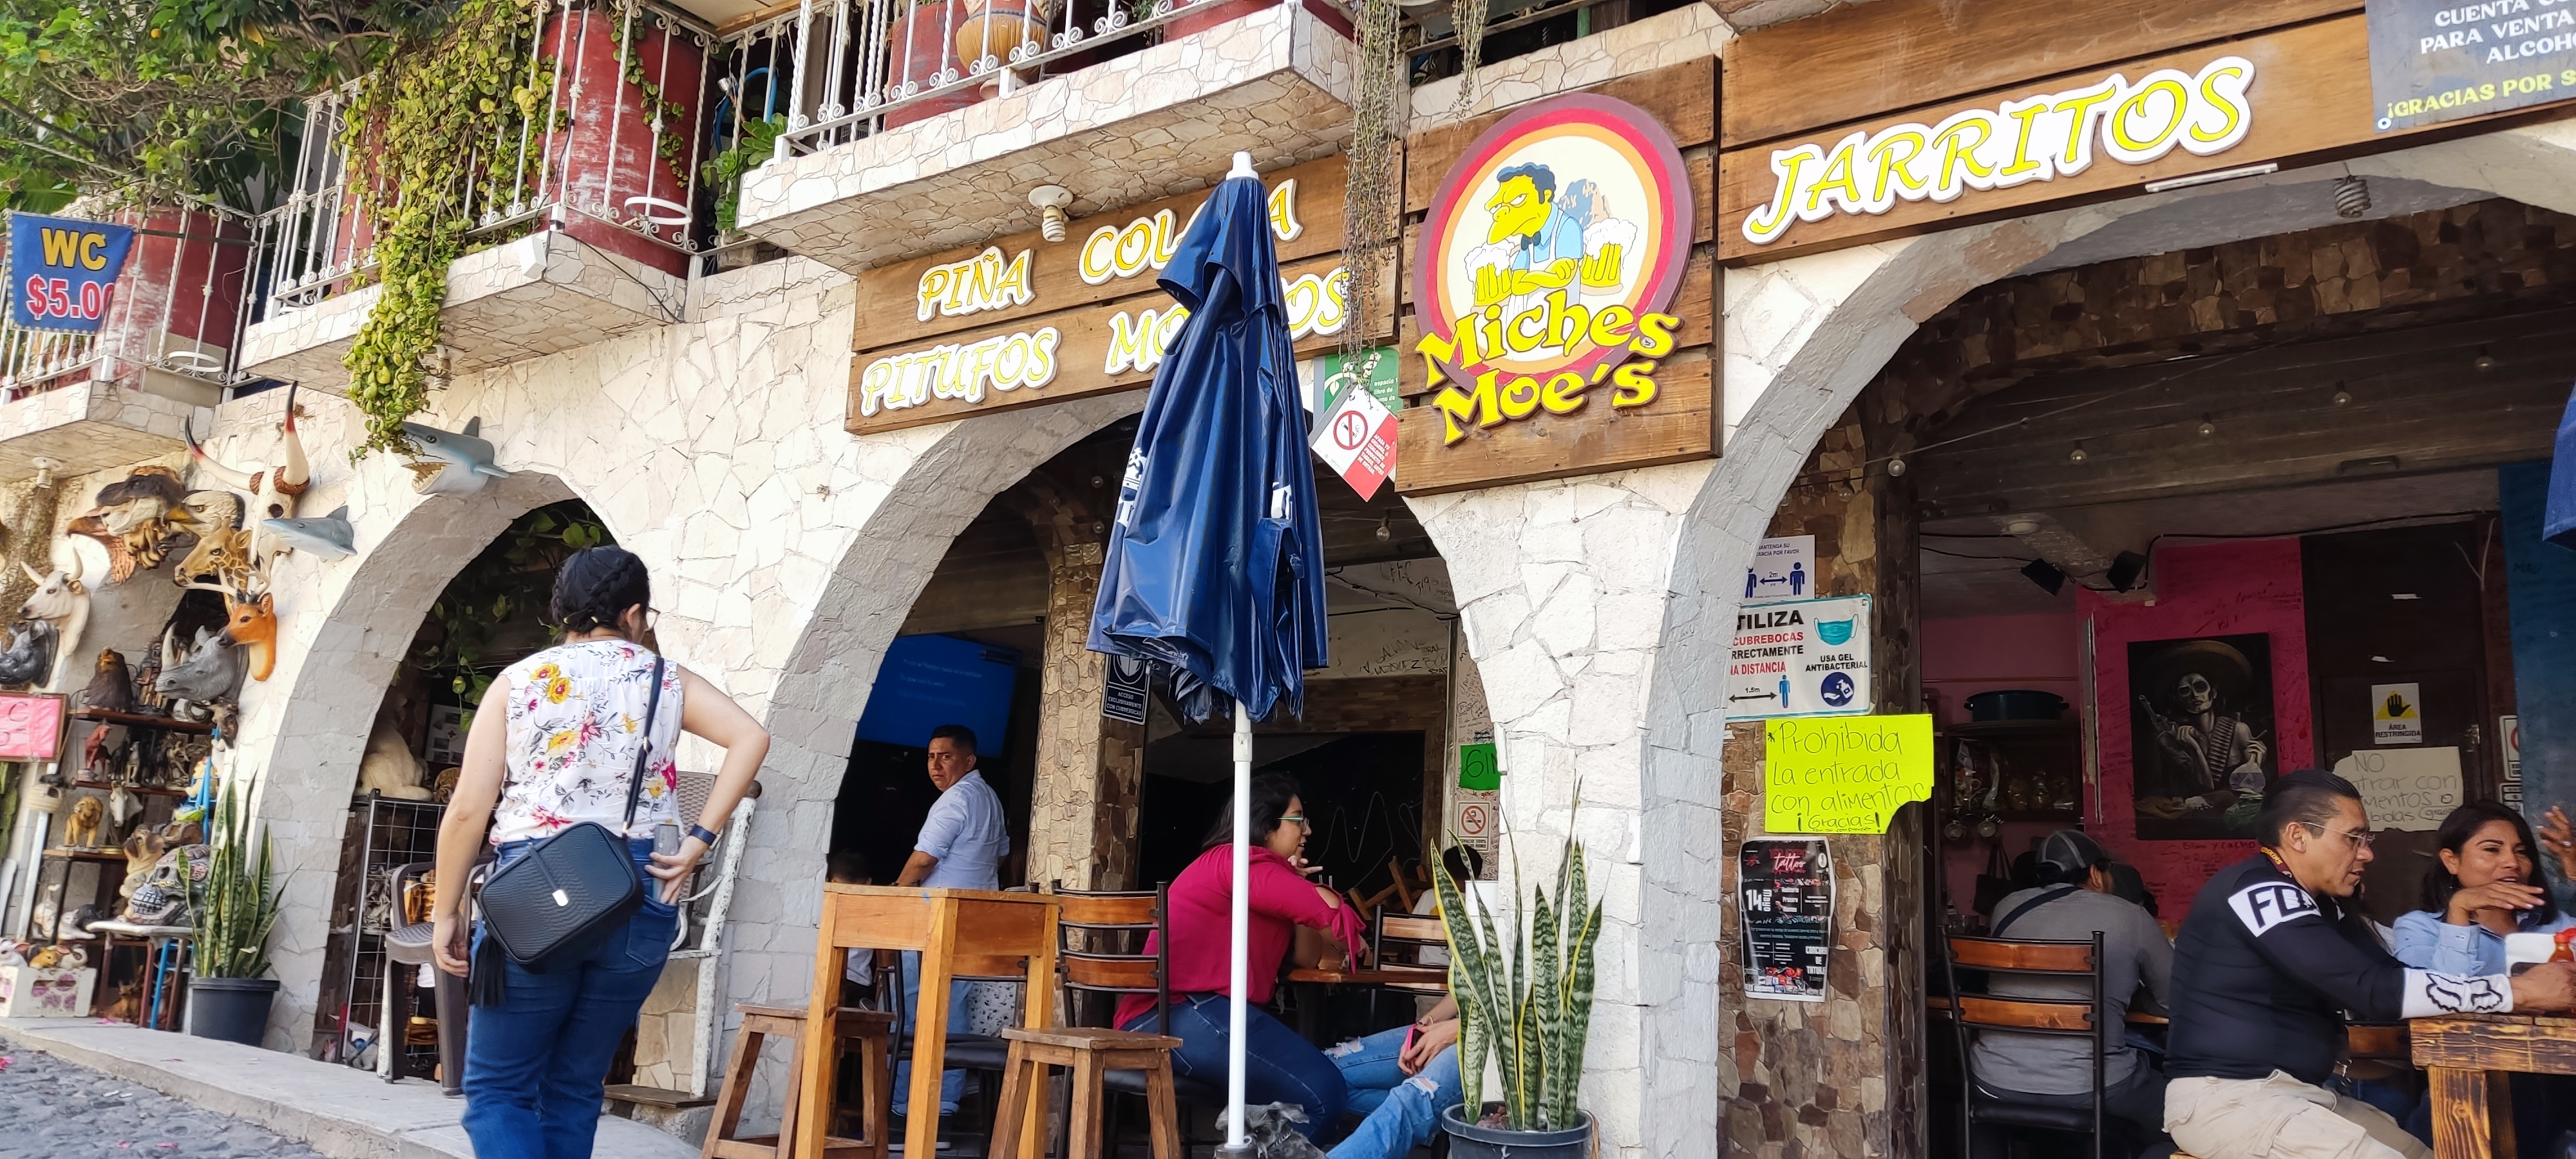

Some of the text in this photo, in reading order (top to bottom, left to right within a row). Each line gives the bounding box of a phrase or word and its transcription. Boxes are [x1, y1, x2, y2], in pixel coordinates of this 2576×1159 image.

[2435, 0, 2530, 27] CUENTA
[2421, 9, 2575, 54] PARA VENTA
[2387, 69, 2576, 118] ¡GRACIAS POR S
[1747, 62, 2248, 238] JARRITOS
[41, 227, 107, 271] WC
[919, 184, 1296, 316] PIÑA COLA
[863, 270, 1351, 413] PITUFOS MOOS
[1416, 289, 1680, 388] Miches
[1431, 361, 1656, 446] Moe's
[1737, 610, 1804, 630] TILIZA
[1733, 632, 1804, 646] CUBREBOCAS
[1732, 645, 1804, 659] RRECTAMENTE
[1741, 661, 1786, 675] DISTANCIA
[1805, 661, 1868, 672] ANTIBACTERIAL
[1108, 696, 1142, 709] EXCLUSIVAMENTE
[1115, 705, 1141, 716] CUBREBOCAS
[1779, 721, 1902, 757] Prohibida
[1774, 759, 1900, 786] La entrada
[2354, 753, 2385, 773] NO
[2351, 775, 2456, 791] ntrar con
[1772, 795, 1810, 816] con
[2363, 792, 2432, 809] mentos
[1797, 812, 1882, 833] ¡Gracias!
[2371, 811, 2416, 822] bidas
[1774, 853, 1806, 871] tattoo
[1746, 889, 1773, 912] 14 MAYO
